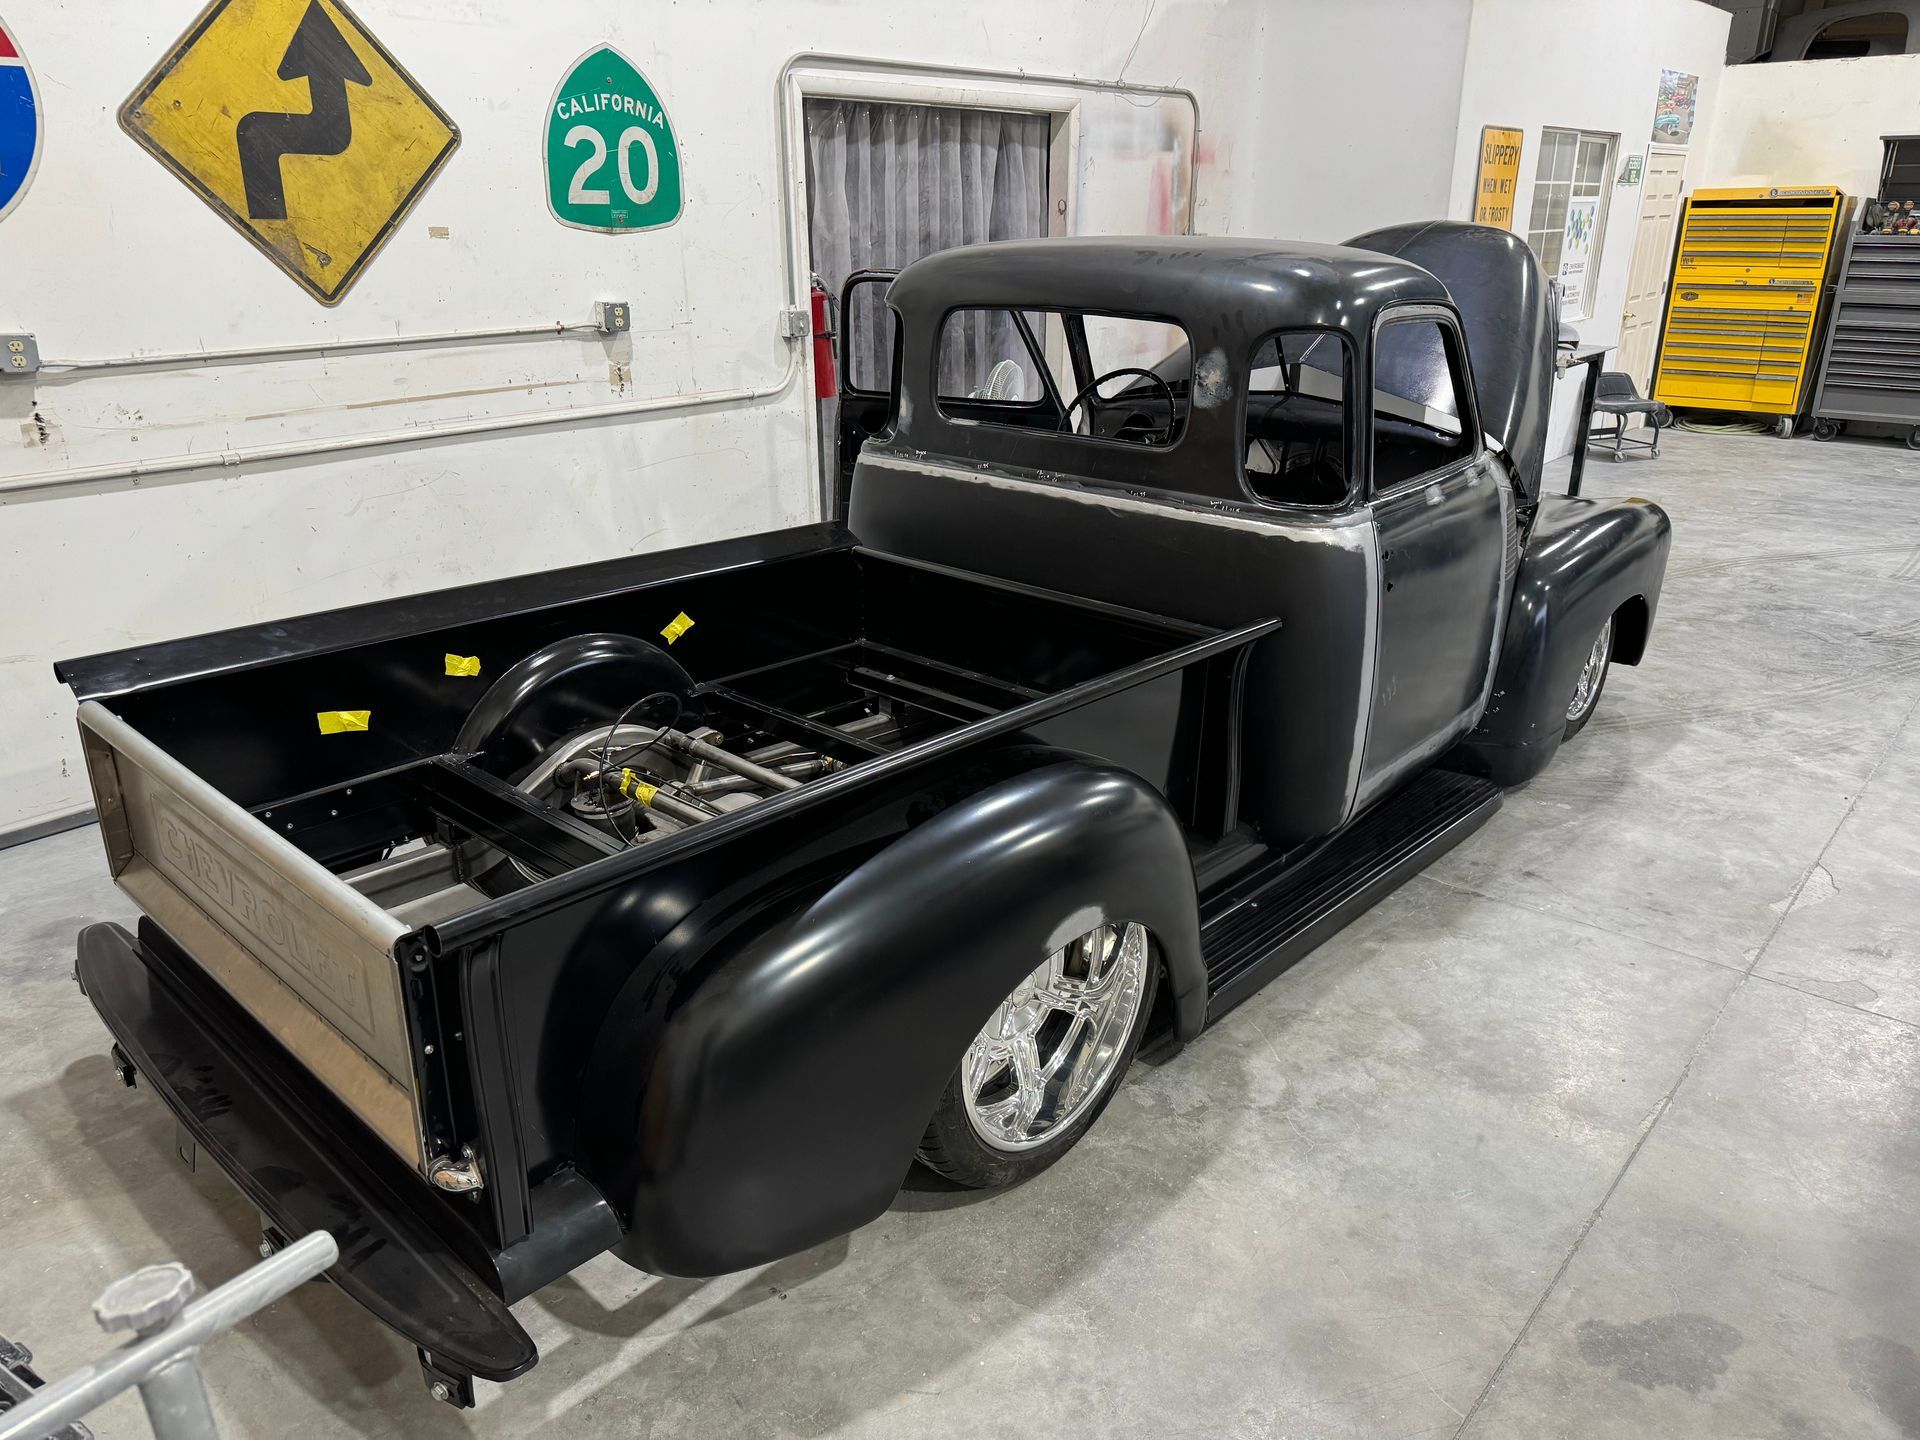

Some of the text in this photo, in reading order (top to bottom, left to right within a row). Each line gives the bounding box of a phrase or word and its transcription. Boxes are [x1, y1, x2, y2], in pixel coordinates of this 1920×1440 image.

[557, 93, 664, 129] CALIFORNIA
[563, 125, 659, 205] 20
[1484, 143, 1520, 166] SLIPPERY
[1483, 177, 1512, 194] WHEN WET
[1479, 206, 1509, 222] OR FROSTY
[166, 823, 358, 1008] CHEVROLET
